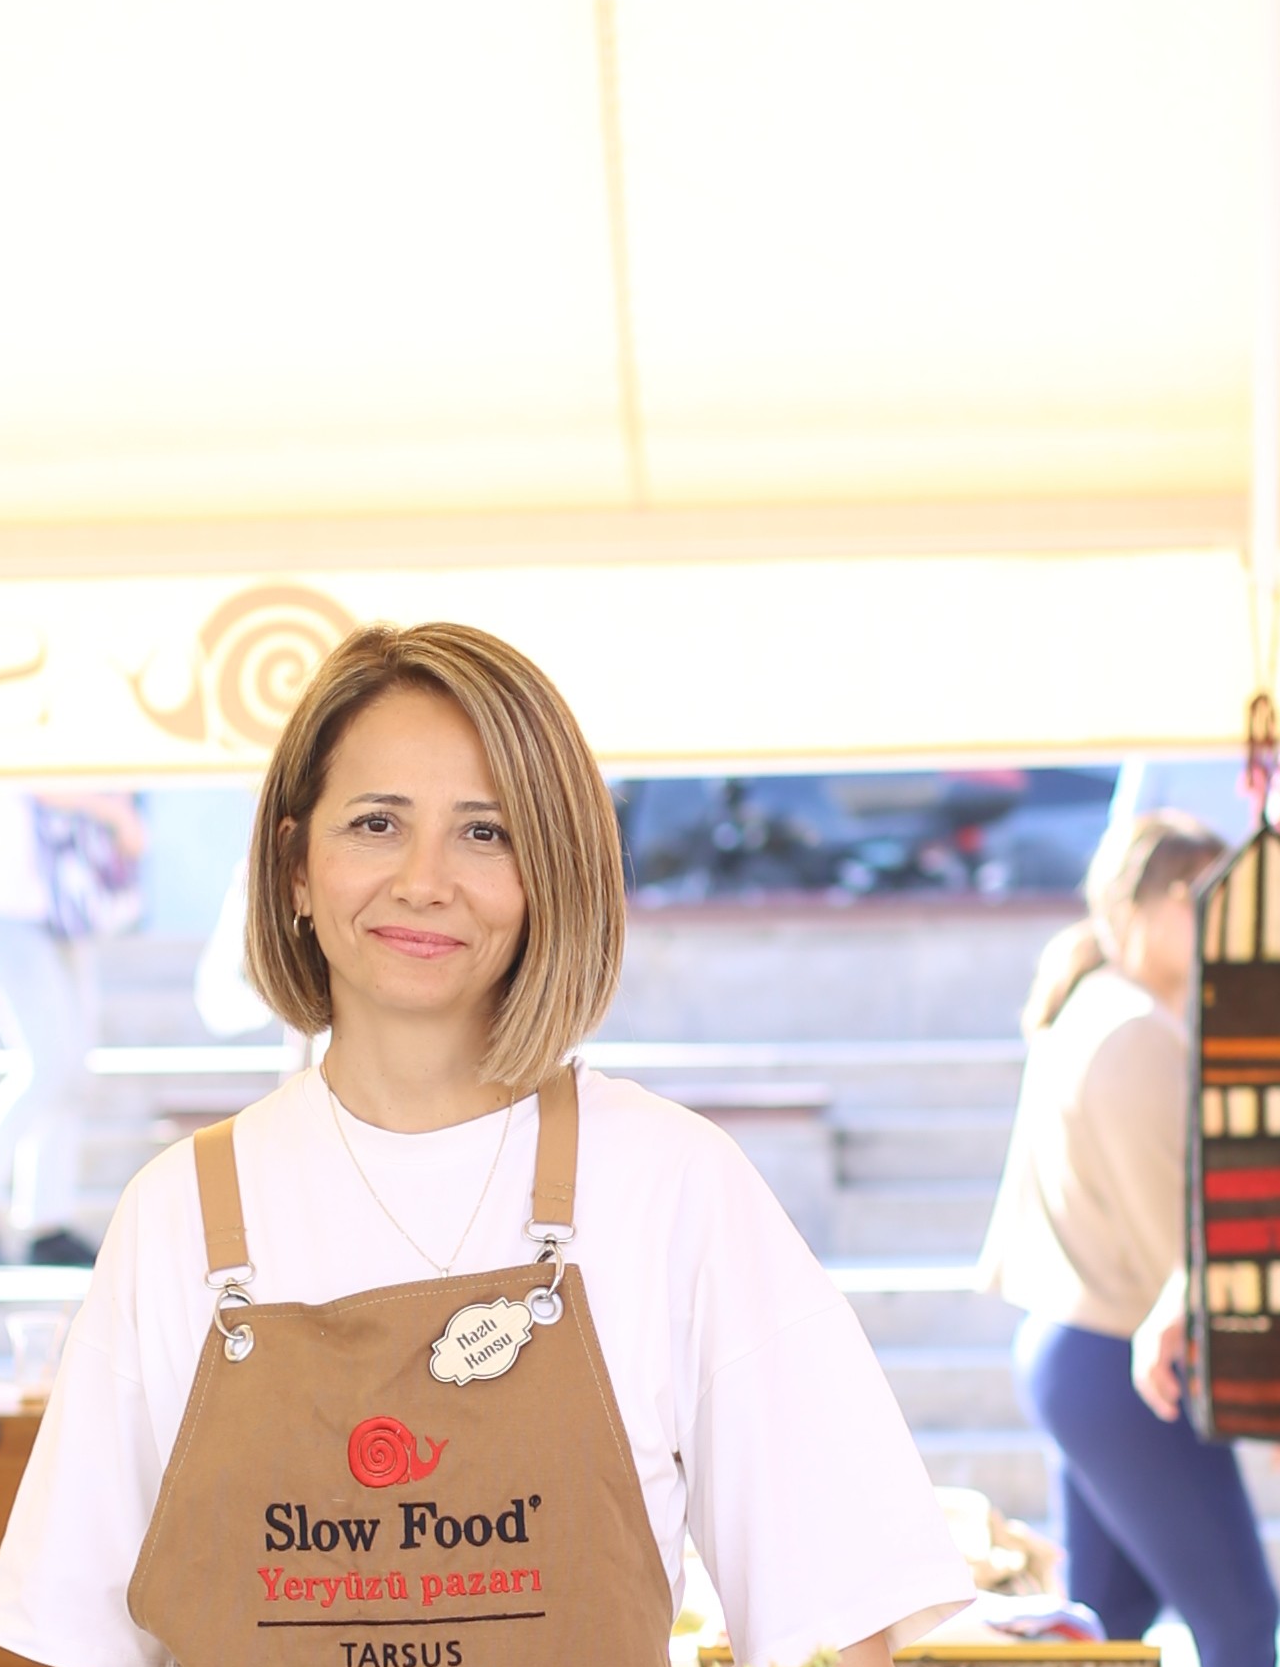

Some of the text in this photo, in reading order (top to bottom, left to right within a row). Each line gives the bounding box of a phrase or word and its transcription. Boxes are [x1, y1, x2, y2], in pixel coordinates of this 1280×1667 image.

[463, 1332, 514, 1370] Kansu
[265, 1502, 381, 1552] Slow
[257, 1566, 543, 1608] Yeryüzü pazarı
